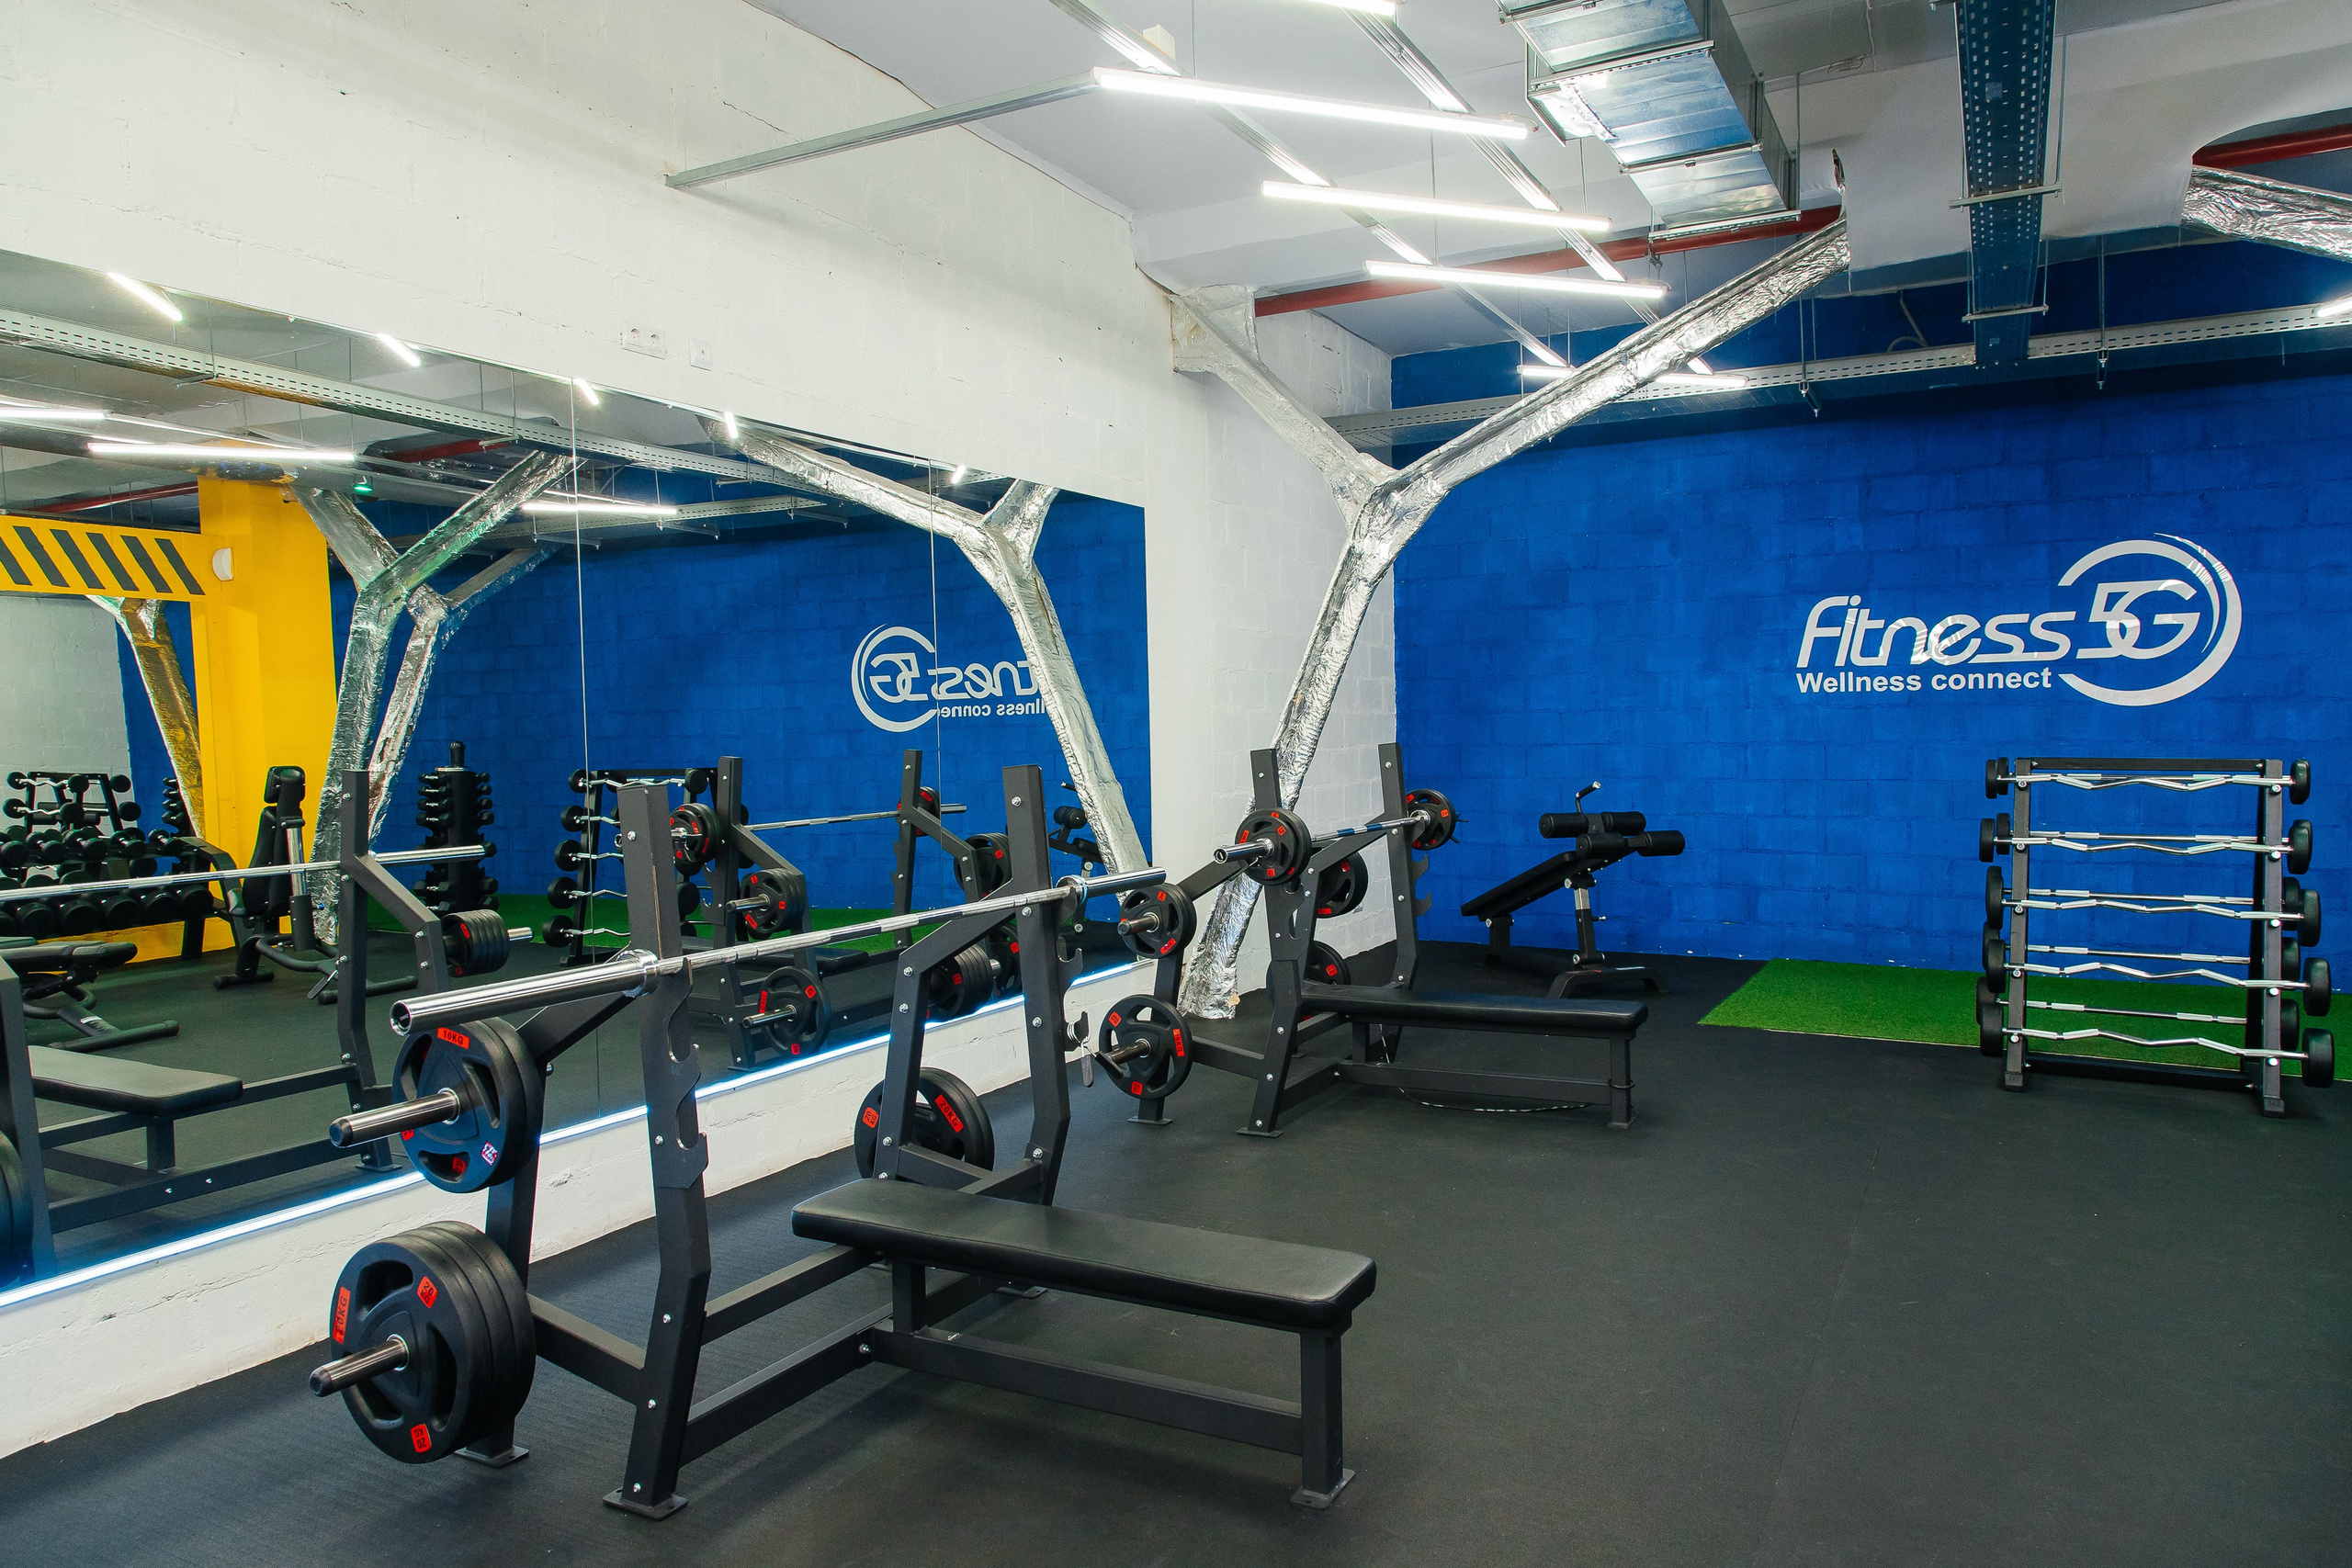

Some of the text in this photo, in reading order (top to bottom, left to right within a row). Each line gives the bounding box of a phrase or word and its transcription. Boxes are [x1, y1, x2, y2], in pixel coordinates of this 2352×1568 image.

[1796, 579, 2200, 669] Fitness 5G
[1796, 668, 2052, 694] Wellness connect
[443, 1030, 464, 1044] 10KG
[864, 1111, 872, 1122] 20
[939, 1100, 959, 1127] 20KG
[423, 1281, 435, 1297] 20
[420, 1290, 431, 1304] KG
[335, 1295, 348, 1337] 20KG
[413, 1427, 424, 1438] KG
[416, 1437, 427, 1450] 20
